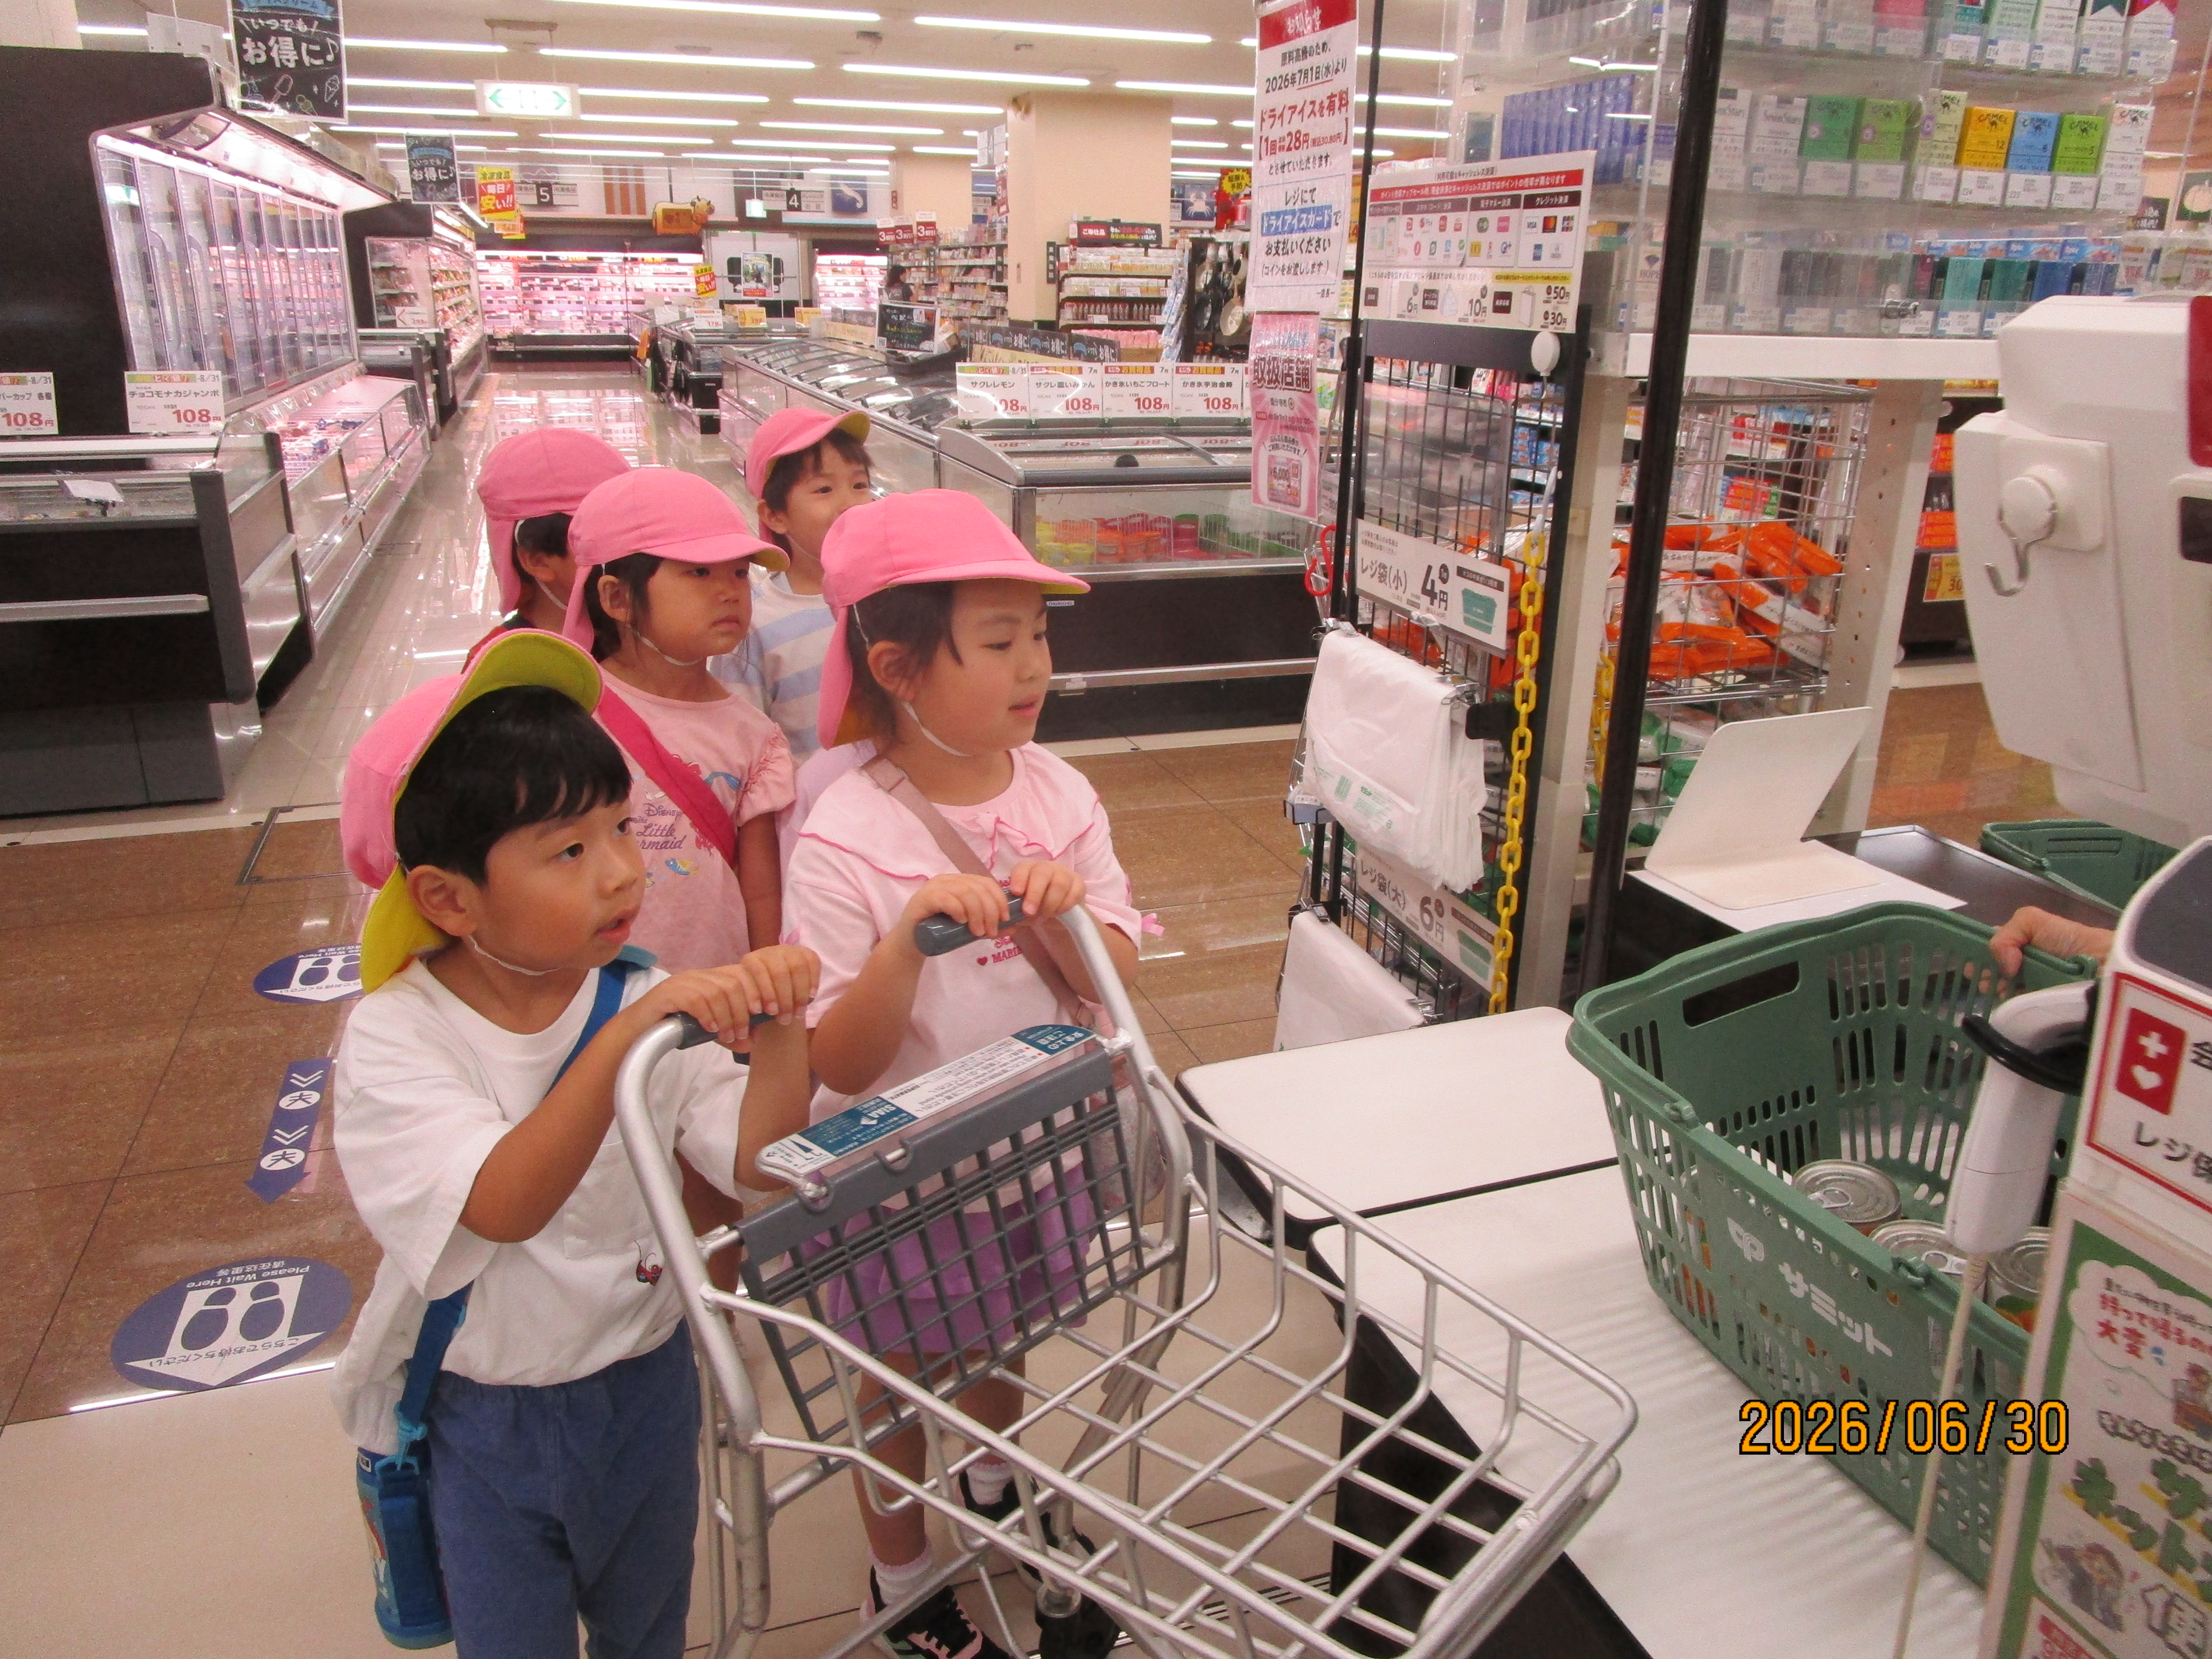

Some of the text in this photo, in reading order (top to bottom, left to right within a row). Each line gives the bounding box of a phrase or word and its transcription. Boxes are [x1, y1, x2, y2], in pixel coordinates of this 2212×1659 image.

[250, 18, 307, 32] いつでも
[1287, 6, 1322, 36] お知らせ
[1265, 57, 1347, 94] 2026年7月1日(水)より
[1260, 88, 1349, 132] ドライアイスを有料
[487, 184, 505, 194] 毎日
[540, 187, 550, 202] 5
[1285, 187, 1316, 206] レジにて
[789, 194, 799, 208] 4
[1265, 236, 1331, 257] お支払いください
[1252, 356, 1312, 392] 取扱店舗
[129, 389, 220, 399] チョコモナカジャンボ
[1064, 398, 1100, 411] 108円
[1134, 397, 1170, 410] 108円
[1203, 397, 1239, 410] 108円
[2, 412, 55, 427] 108円
[172, 408, 222, 424] 108円
[1360, 557, 1407, 594] レジ袋(小)
[636, 823, 676, 837] Little
[638, 834, 687, 850] rmaid
[866, 1103, 897, 1119] SIAA
[186, 1264, 310, 1289] Please Wait Here
[149, 1337, 301, 1368] こちらでお待ちください
